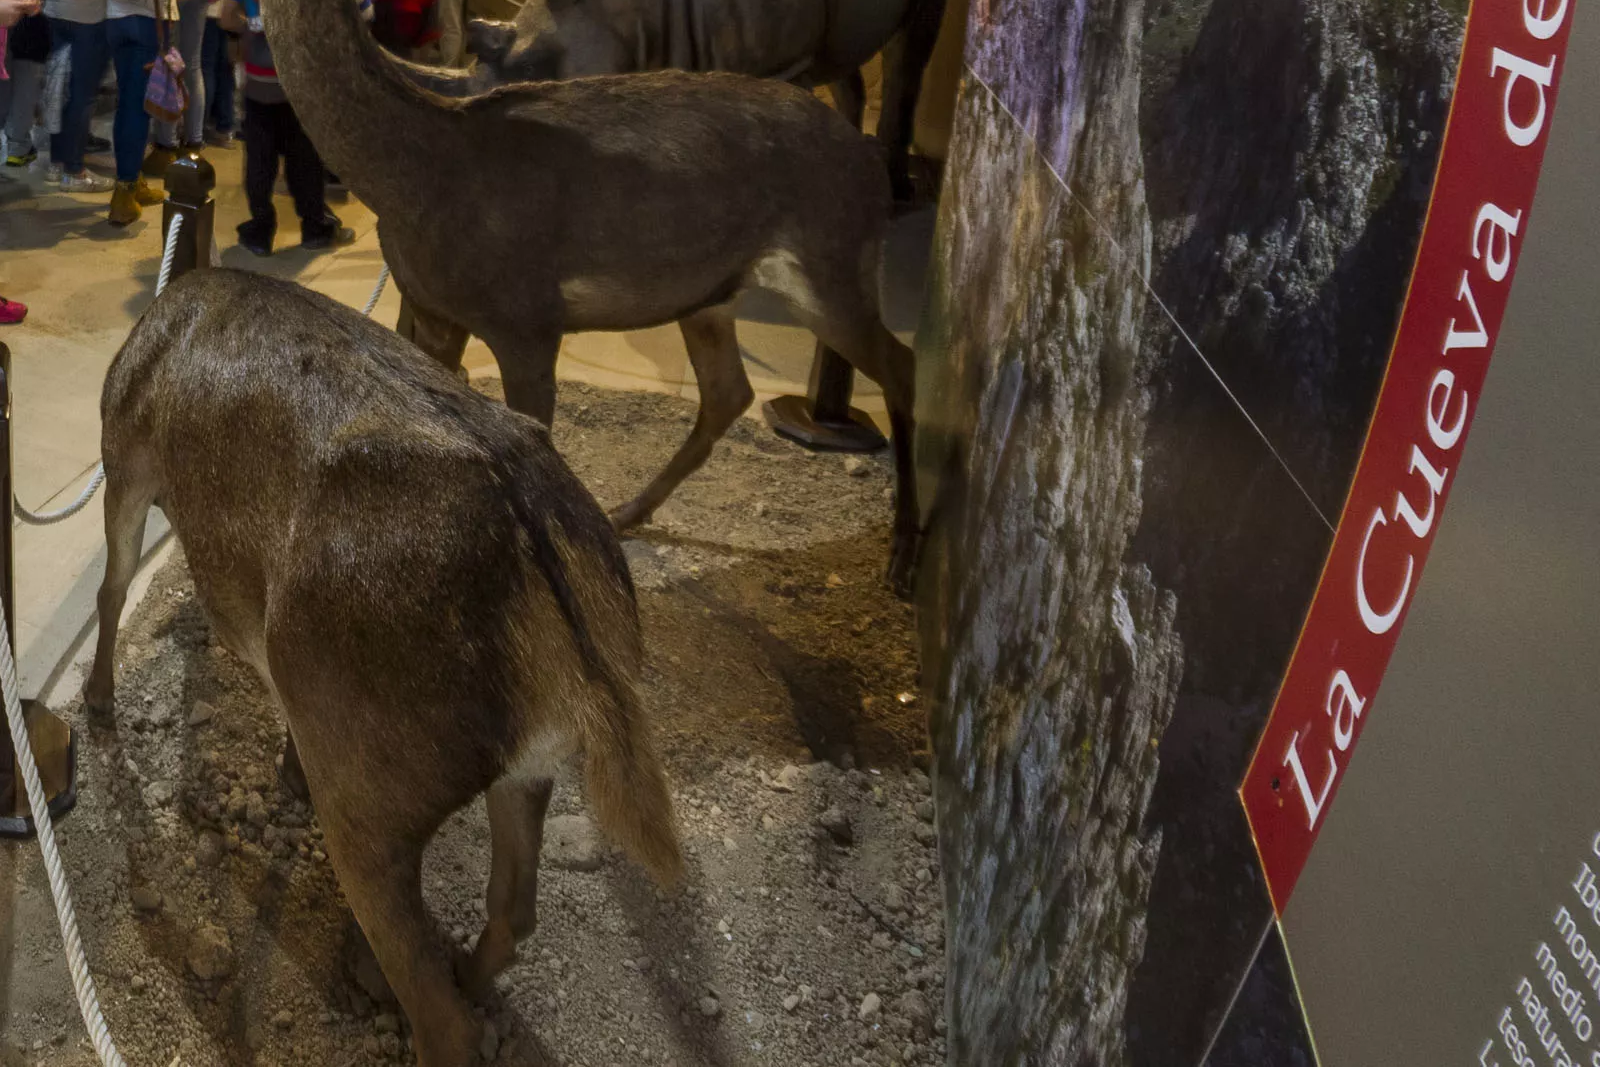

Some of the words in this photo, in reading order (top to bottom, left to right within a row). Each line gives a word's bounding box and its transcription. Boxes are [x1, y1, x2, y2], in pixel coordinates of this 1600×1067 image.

[1281, 668, 1367, 832] La
[1355, 200, 1522, 636] Cueva
[1536, 942, 1593, 1042] medio
[1554, 906, 1600, 1001] mom
[1516, 977, 1581, 1067] natura
